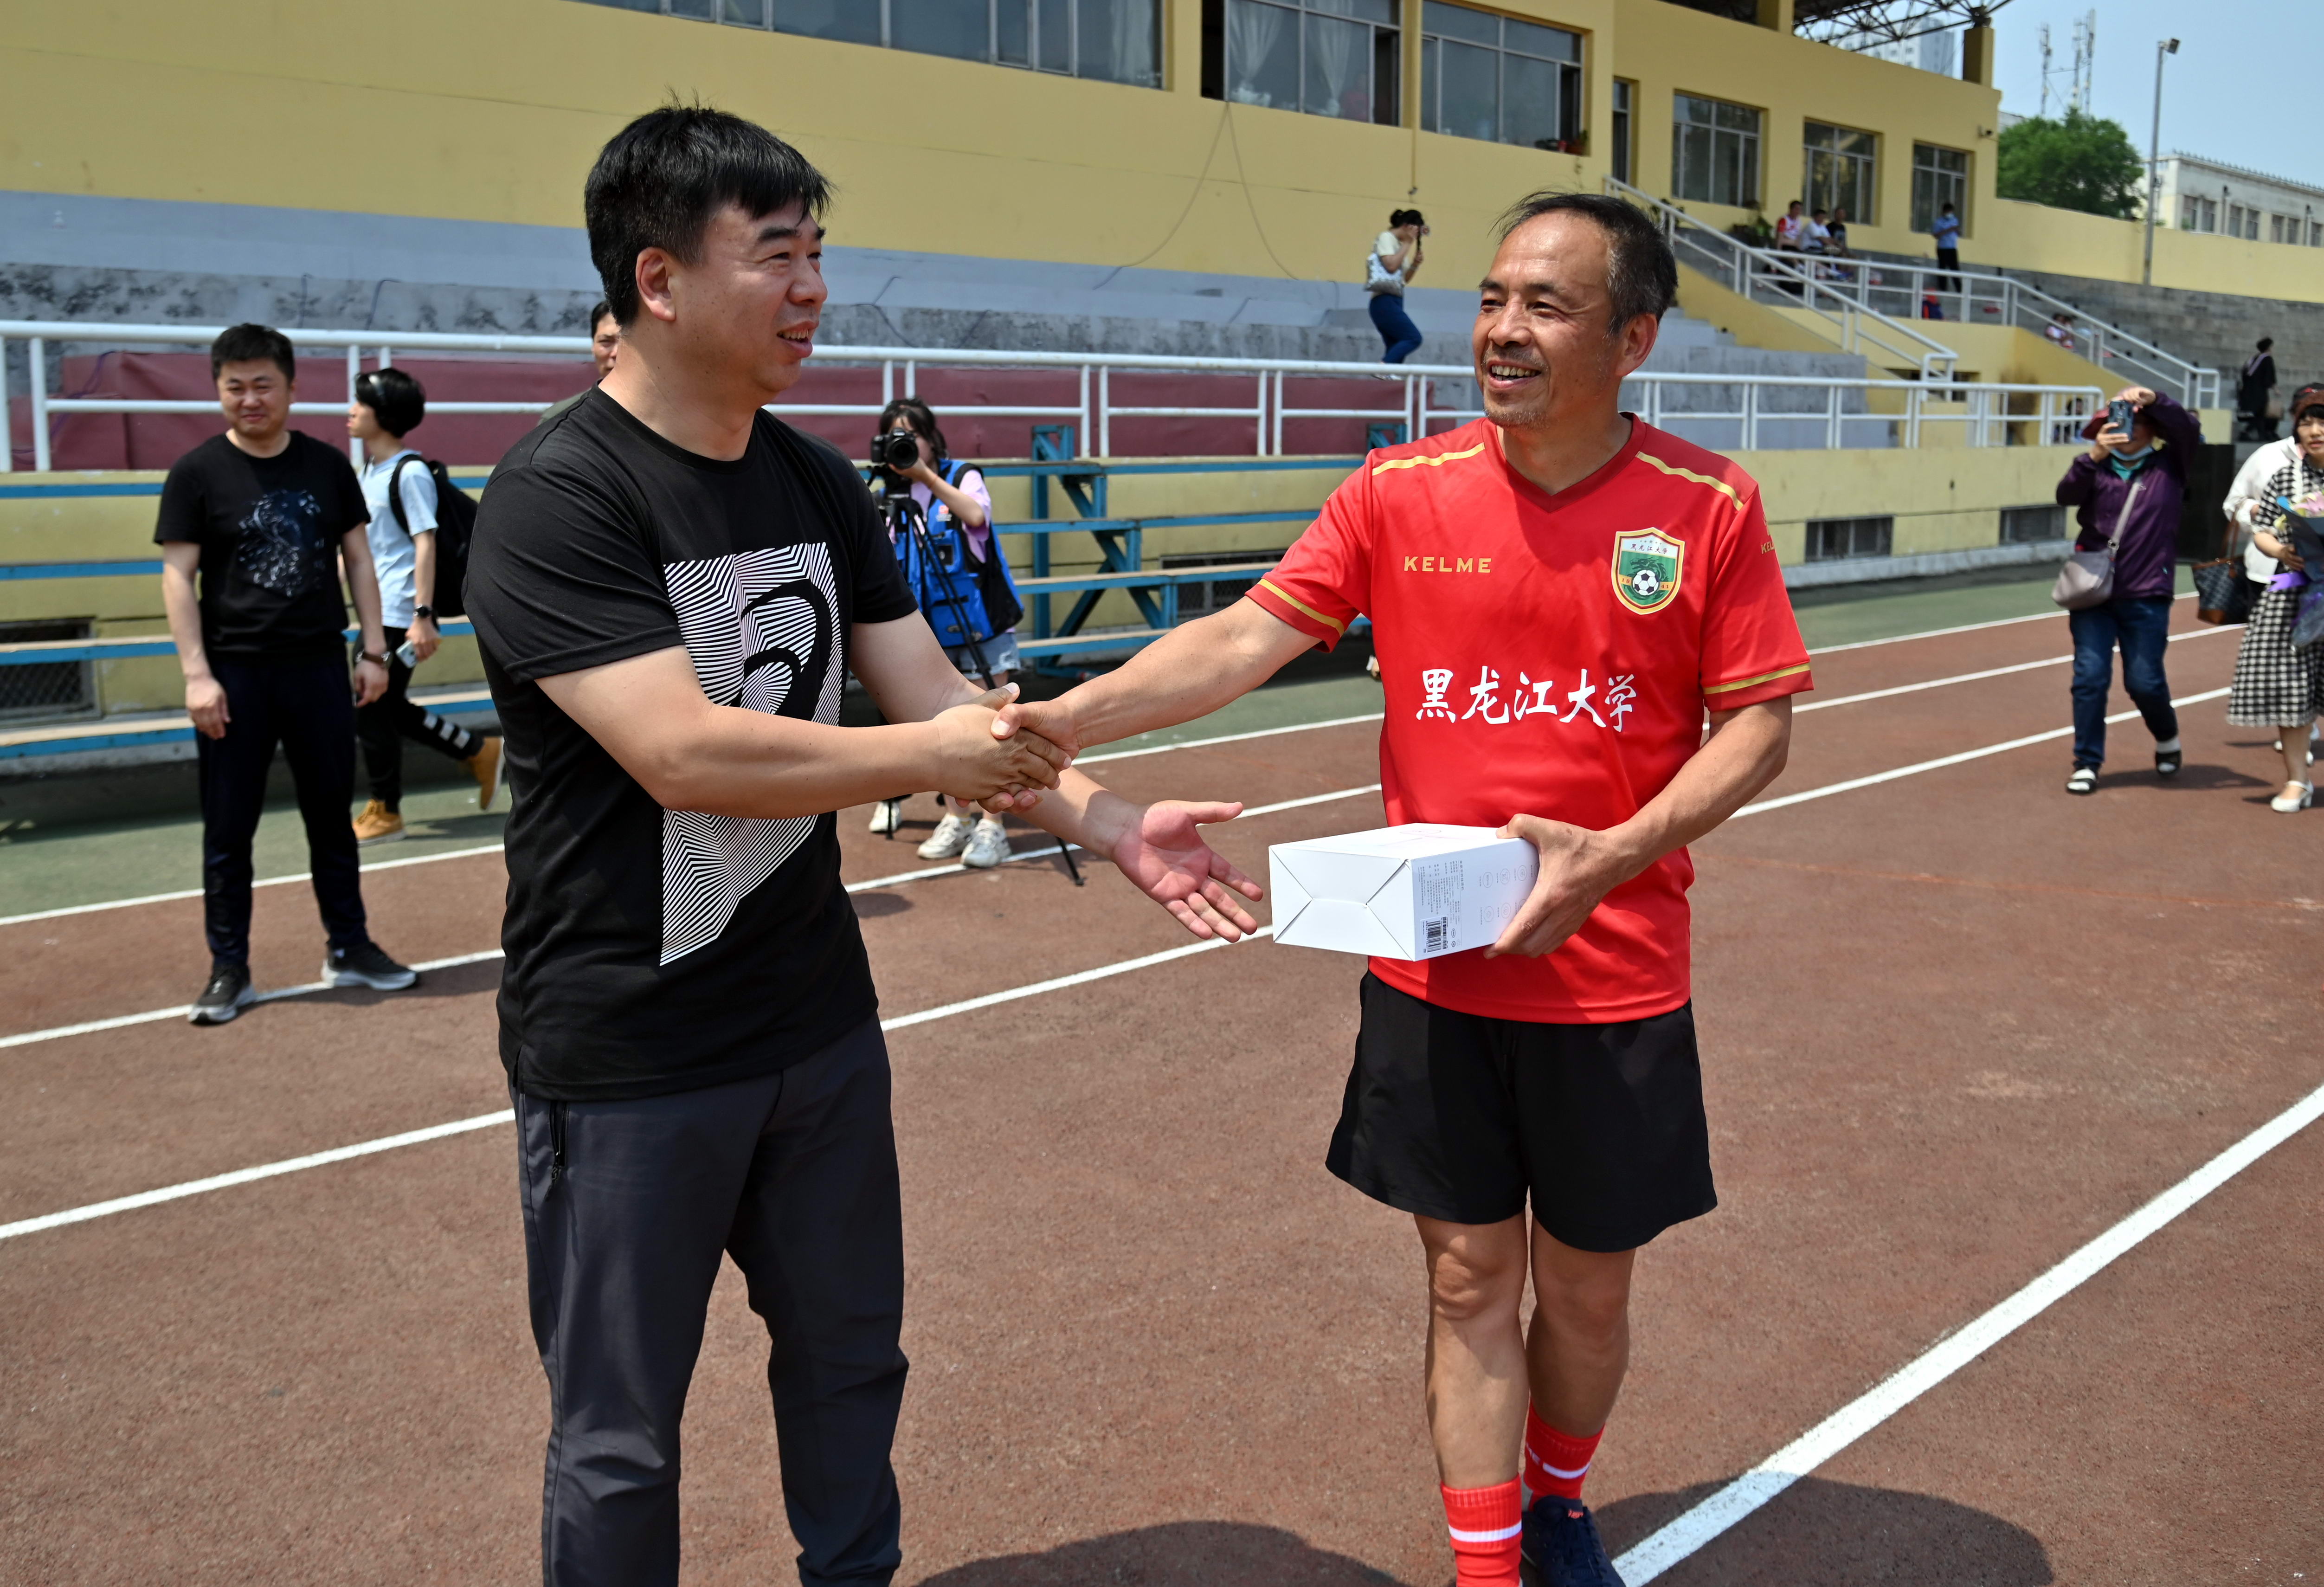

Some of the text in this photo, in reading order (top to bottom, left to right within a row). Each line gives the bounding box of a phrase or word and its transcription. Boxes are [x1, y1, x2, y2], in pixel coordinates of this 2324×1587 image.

[1403, 556, 1491, 573] KELME
[1416, 665, 1637, 732] 黑龙江大学
